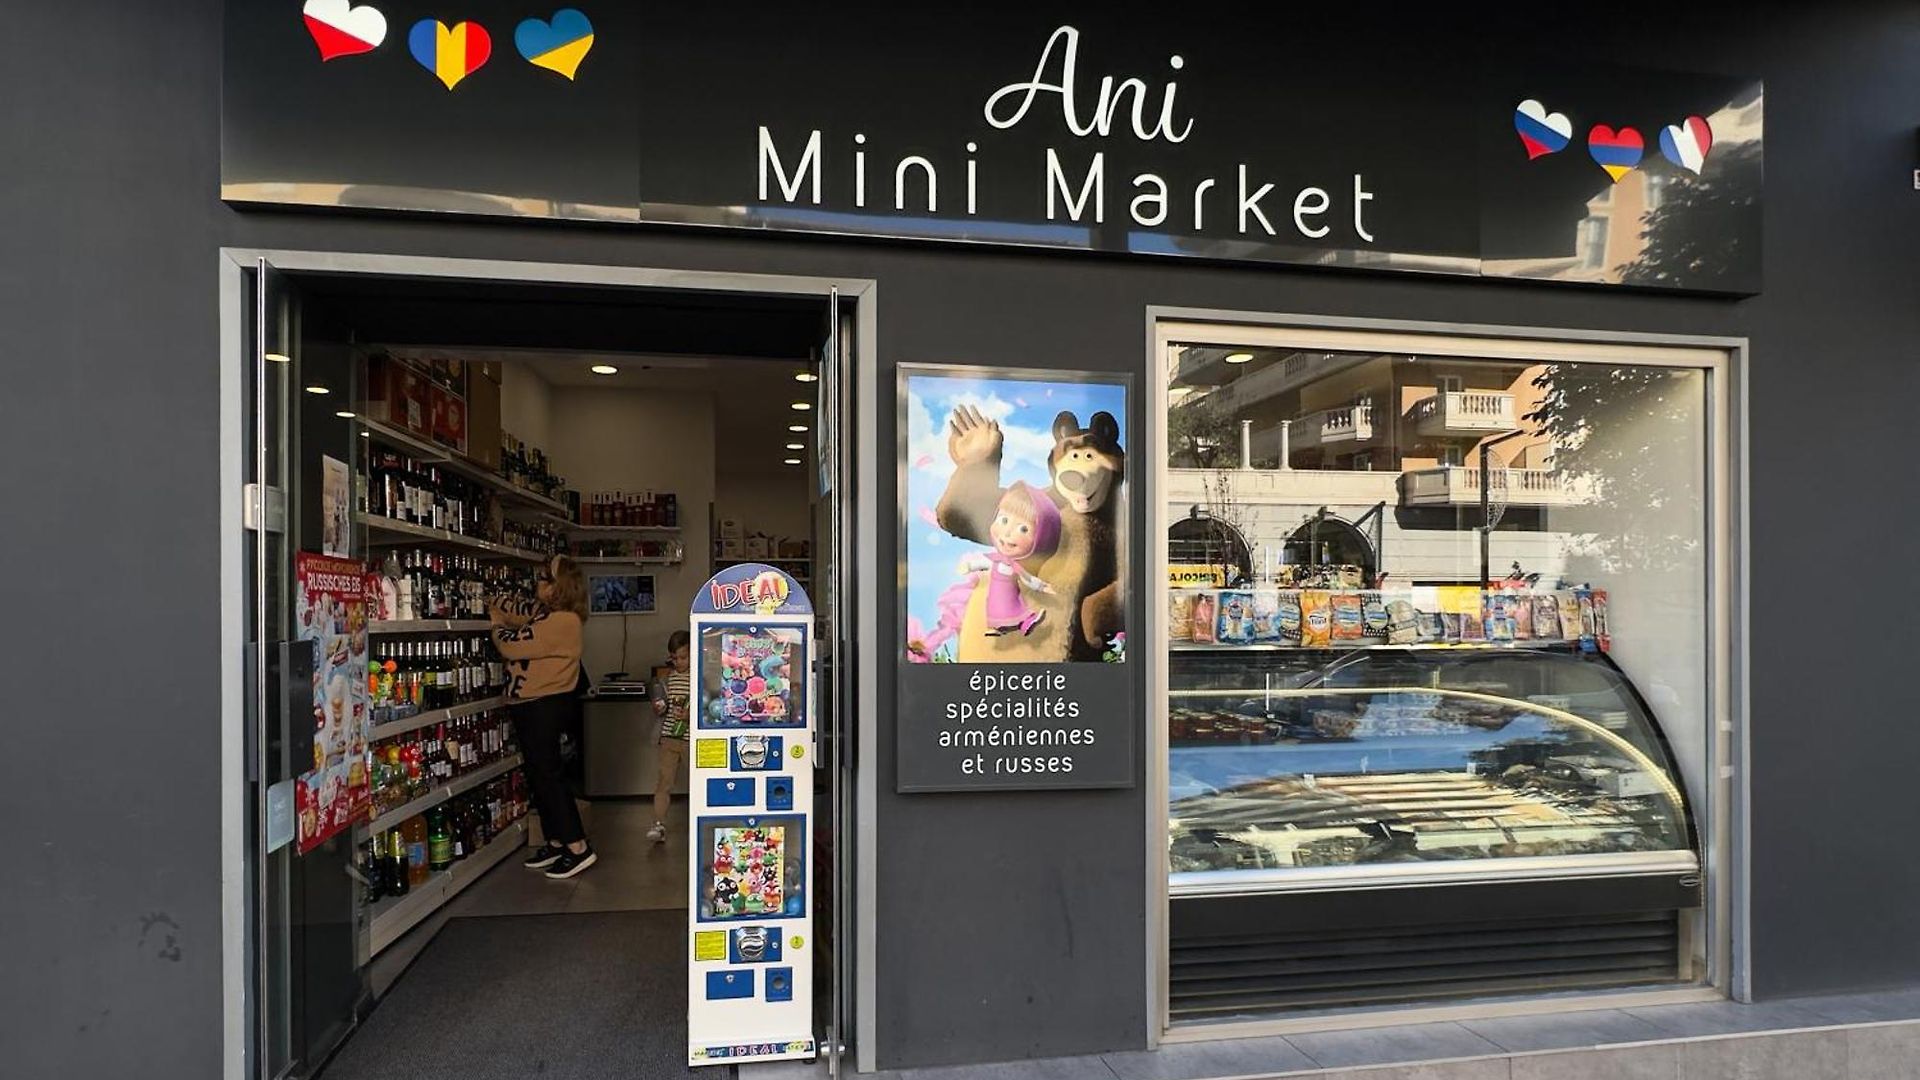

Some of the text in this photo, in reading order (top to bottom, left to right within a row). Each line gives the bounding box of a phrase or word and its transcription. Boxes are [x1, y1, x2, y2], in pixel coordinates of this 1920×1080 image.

[984, 25, 1194, 143] Ani
[758, 125, 1374, 243] Mini Market
[969, 670, 1066, 695] épicerie
[946, 697, 1080, 724] spécialités
[938, 725, 1095, 747] arméniennes
[961, 753, 1073, 774] et russes
